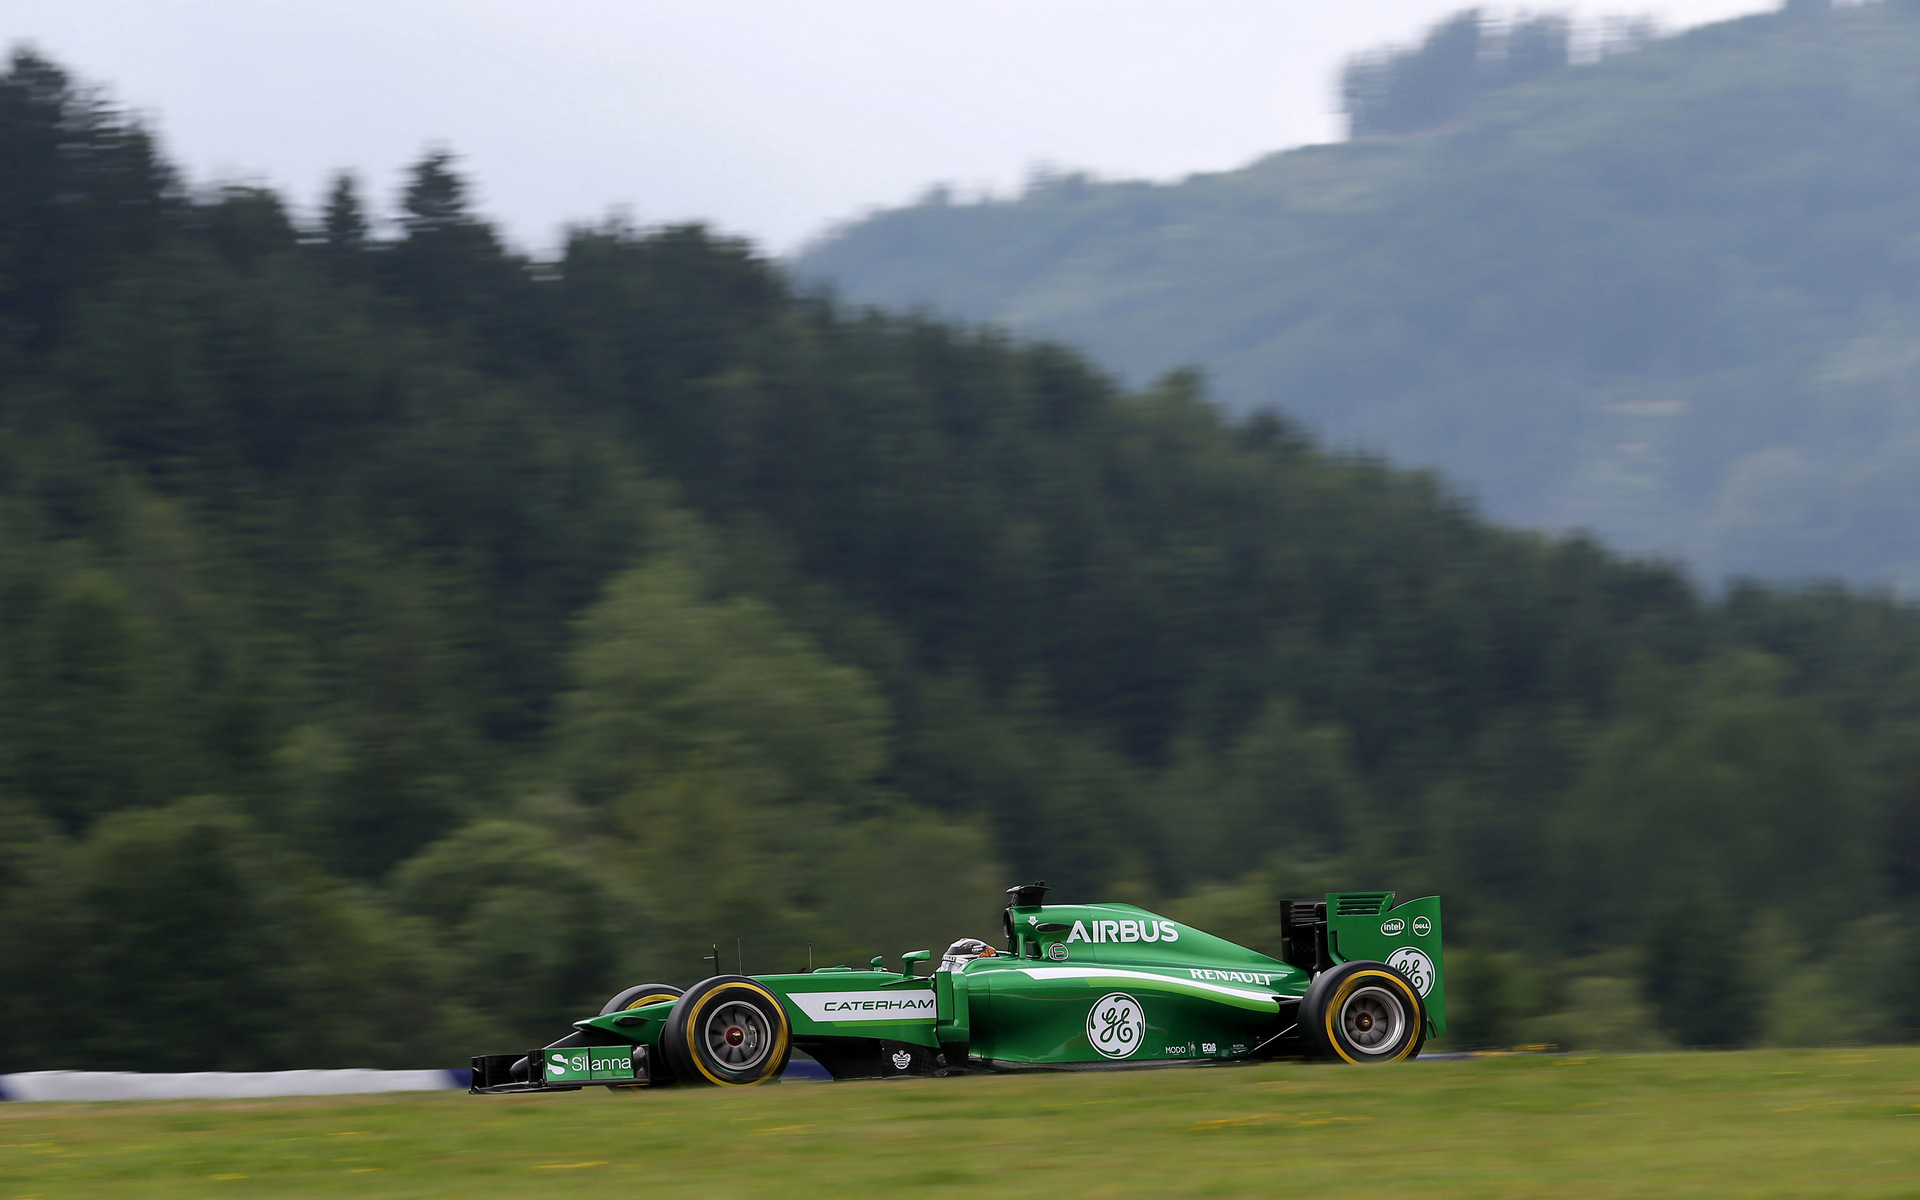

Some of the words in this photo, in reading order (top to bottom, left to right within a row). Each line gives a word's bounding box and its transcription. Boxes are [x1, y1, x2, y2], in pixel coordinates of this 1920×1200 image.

[1066, 920, 1179, 943] AIRBUS
[1383, 921, 1401, 931] intel
[1188, 968, 1272, 986] RENAULT
[823, 999, 935, 1012] CATERHAM
[1165, 1046, 1186, 1054] MODO
[571, 1056, 632, 1072] Silanna
